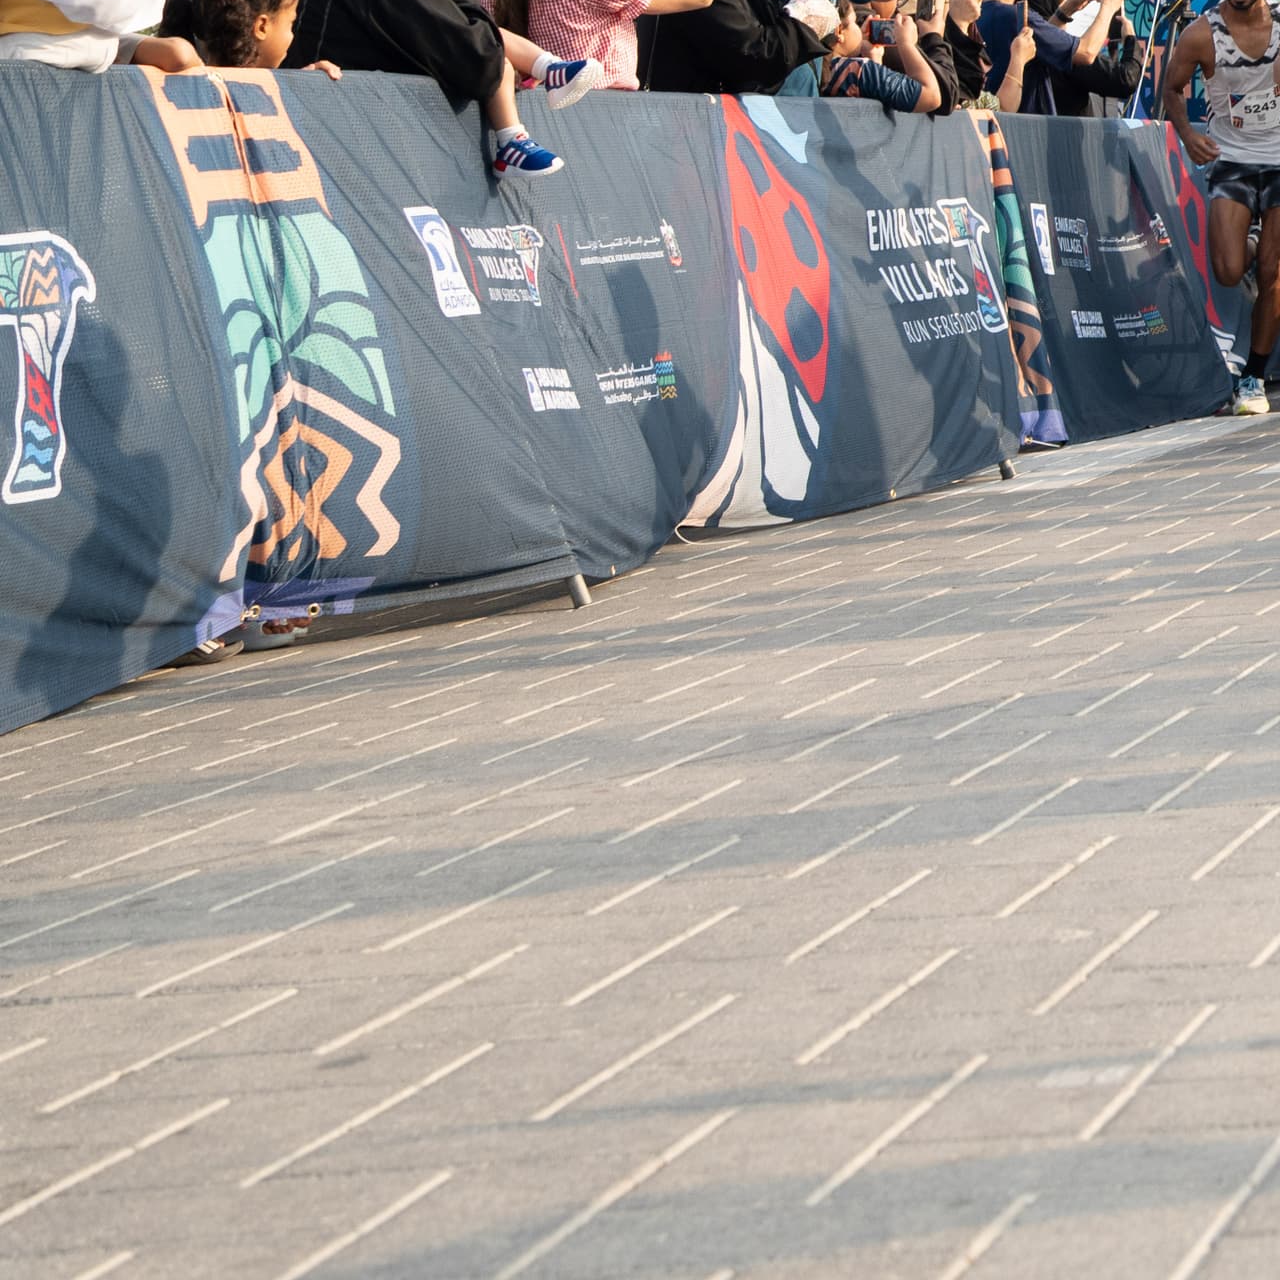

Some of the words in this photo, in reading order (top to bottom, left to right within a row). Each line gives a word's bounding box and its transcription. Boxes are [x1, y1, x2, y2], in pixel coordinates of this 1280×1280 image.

[1244, 99, 1277, 114] 5243
[866, 205, 950, 251] EMIRATES
[879, 258, 969, 304] VILLAGES
[902, 320, 932, 343] RUN
